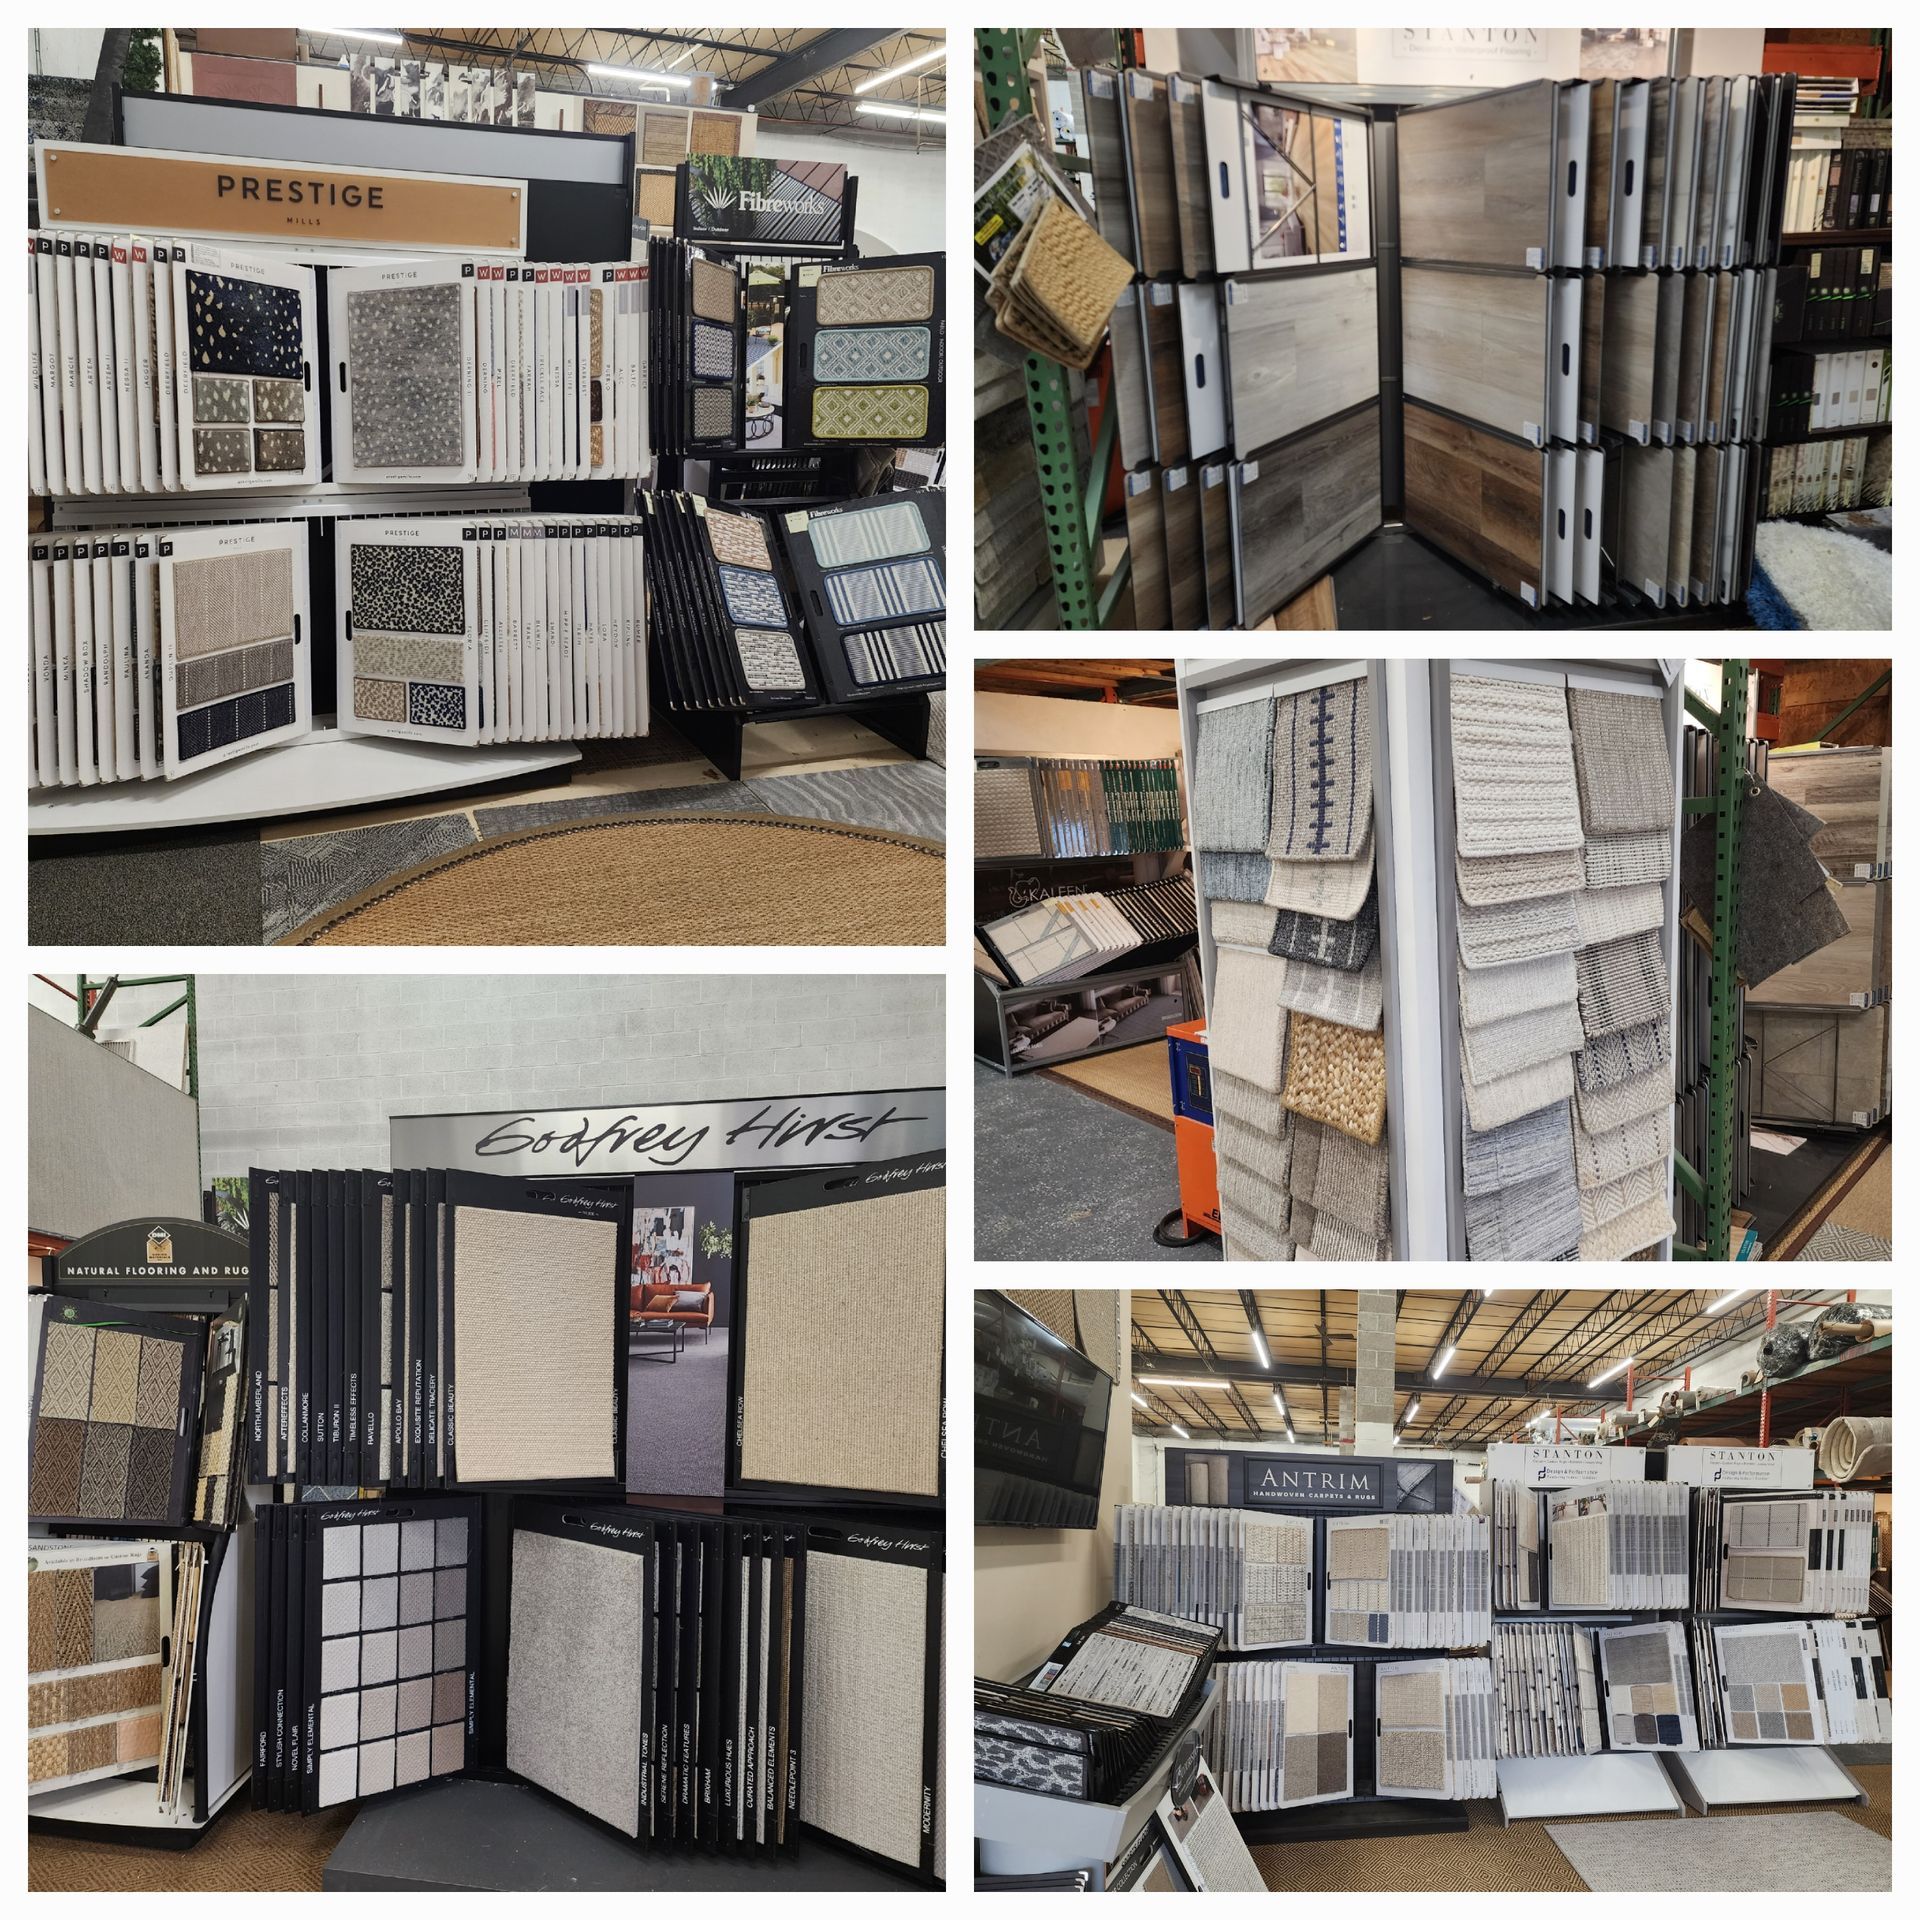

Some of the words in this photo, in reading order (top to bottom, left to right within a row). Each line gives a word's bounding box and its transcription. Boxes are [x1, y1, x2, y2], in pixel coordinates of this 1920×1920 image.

[1402, 28, 1538, 44] STANTON
[217, 175, 384, 209] PRESTIGE
[738, 190, 825, 216] Fibreworks
[286, 216, 321, 226] MILLS
[230, 262, 266, 276] PRESTIGE
[382, 272, 418, 280] PRESTIGE
[822, 264, 860, 273] Fibreworks
[32, 352, 40, 390] WILDLIFE
[142, 358, 150, 389] JAGGER
[809, 506, 844, 518] Fibreworks
[218, 536, 256, 546] PRESTIGE
[475, 1114, 710, 1168] Godfrey
[726, 1104, 928, 1150] Hirst
[865, 1167, 913, 1184] Godfrey
[560, 1194, 595, 1208] Godfrey
[596, 1198, 619, 1209] Hirst
[68, 1266, 120, 1275] NATURAL
[126, 1266, 187, 1275] FLOORING
[193, 1266, 218, 1275] AND
[1533, 1449, 1603, 1459] STANTON
[1710, 1451, 1775, 1461] STANTON
[1260, 1468, 1370, 1490] ANTRIM
[320, 1509, 356, 1522] Godfrey
[357, 1508, 381, 1517] Hirst
[590, 1522, 622, 1539] Godfrey
[622, 1528, 647, 1540] Hirst
[847, 1533, 894, 1552] Godfrey
[895, 1540, 931, 1552] Hirst
[922, 1786, 931, 1834] MODERNITY
